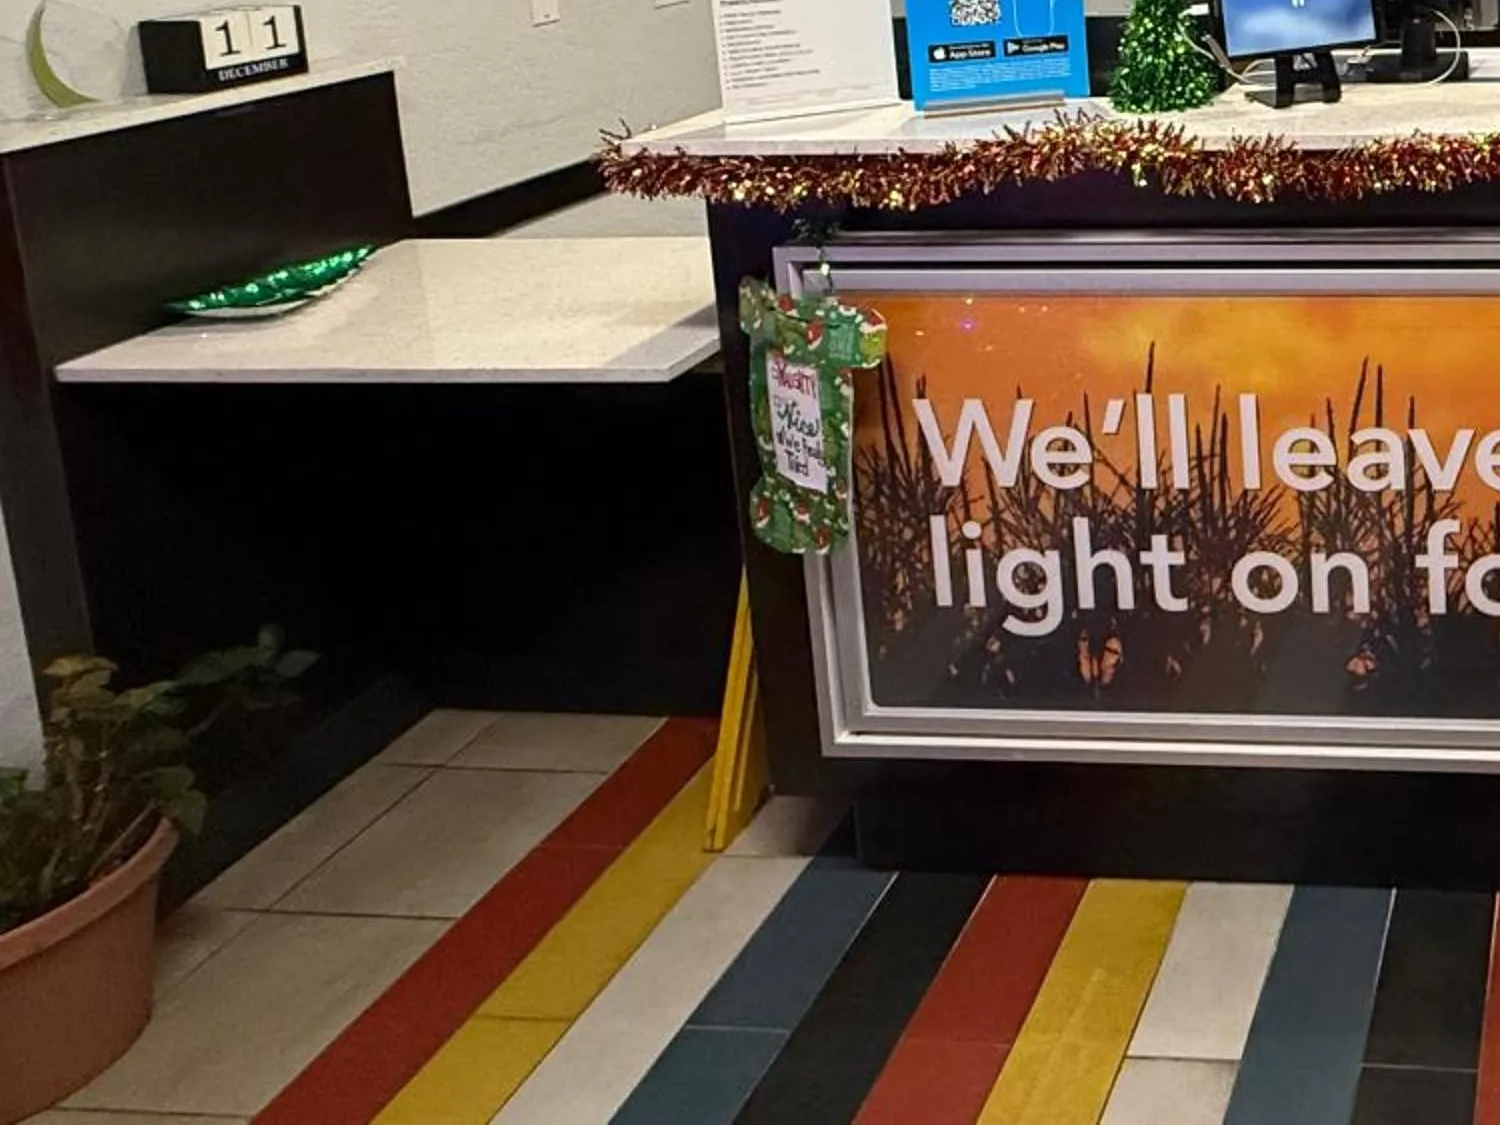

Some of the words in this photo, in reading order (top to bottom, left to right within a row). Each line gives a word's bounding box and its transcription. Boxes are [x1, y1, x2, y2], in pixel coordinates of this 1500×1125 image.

[218, 58, 289, 82] DECEMBER
[912, 393, 1191, 491] We'll
[929, 515, 1189, 638] light
[1231, 549, 1371, 614] on
